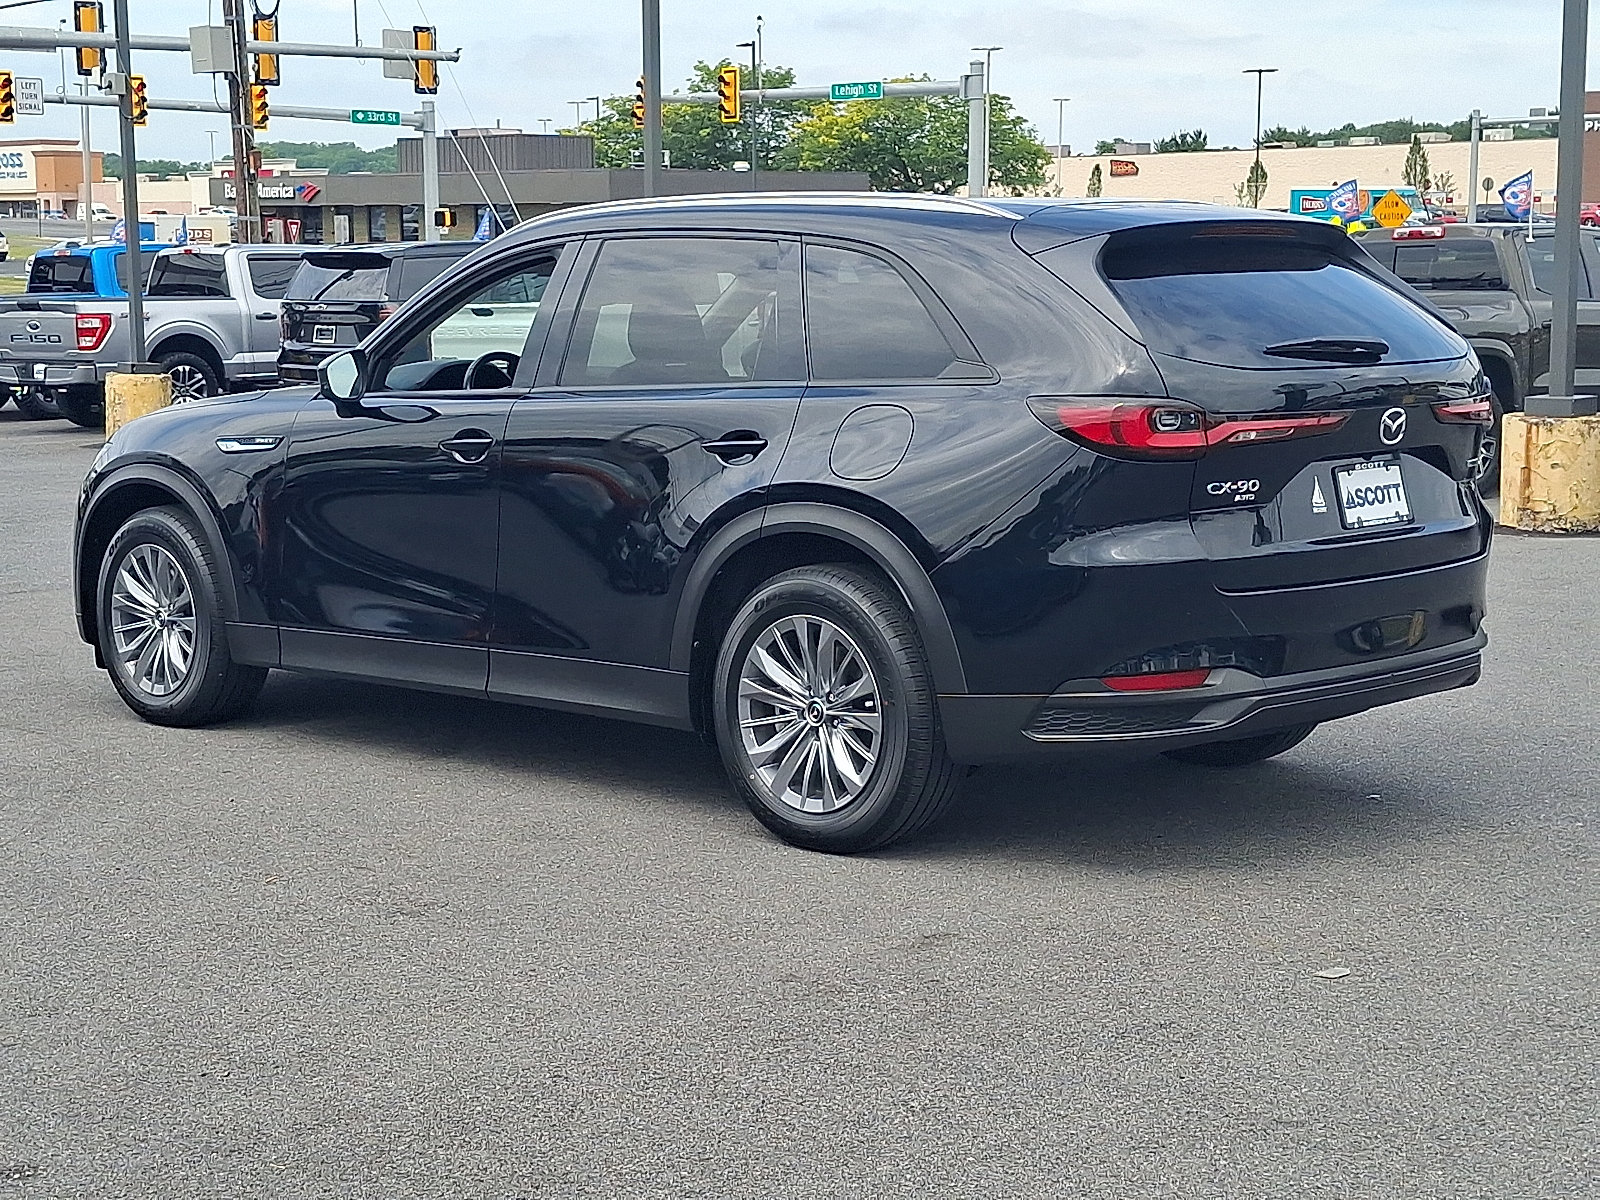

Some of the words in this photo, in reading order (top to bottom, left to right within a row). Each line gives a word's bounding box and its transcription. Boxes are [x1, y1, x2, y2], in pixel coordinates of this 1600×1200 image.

[20, 82, 37, 90] LEFT
[835, 84, 864, 97] Lehigh
[867, 84, 878, 94] St
[20, 92, 38, 100] TURN
[18, 103, 41, 111] SIGNAL
[367, 112, 385, 121] 33rd
[387, 113, 397, 122] St
[0, 152, 23, 168] OSS
[224, 183, 237, 199] Ba
[257, 183, 294, 199] America
[1384, 200, 1399, 209] SLOW
[1379, 212, 1404, 221] CAUTION
[9, 334, 62, 344] F-150
[1354, 461, 1385, 470] SCOTT
[1206, 479, 1260, 495] CX-90
[1354, 483, 1401, 508] SCOTT
